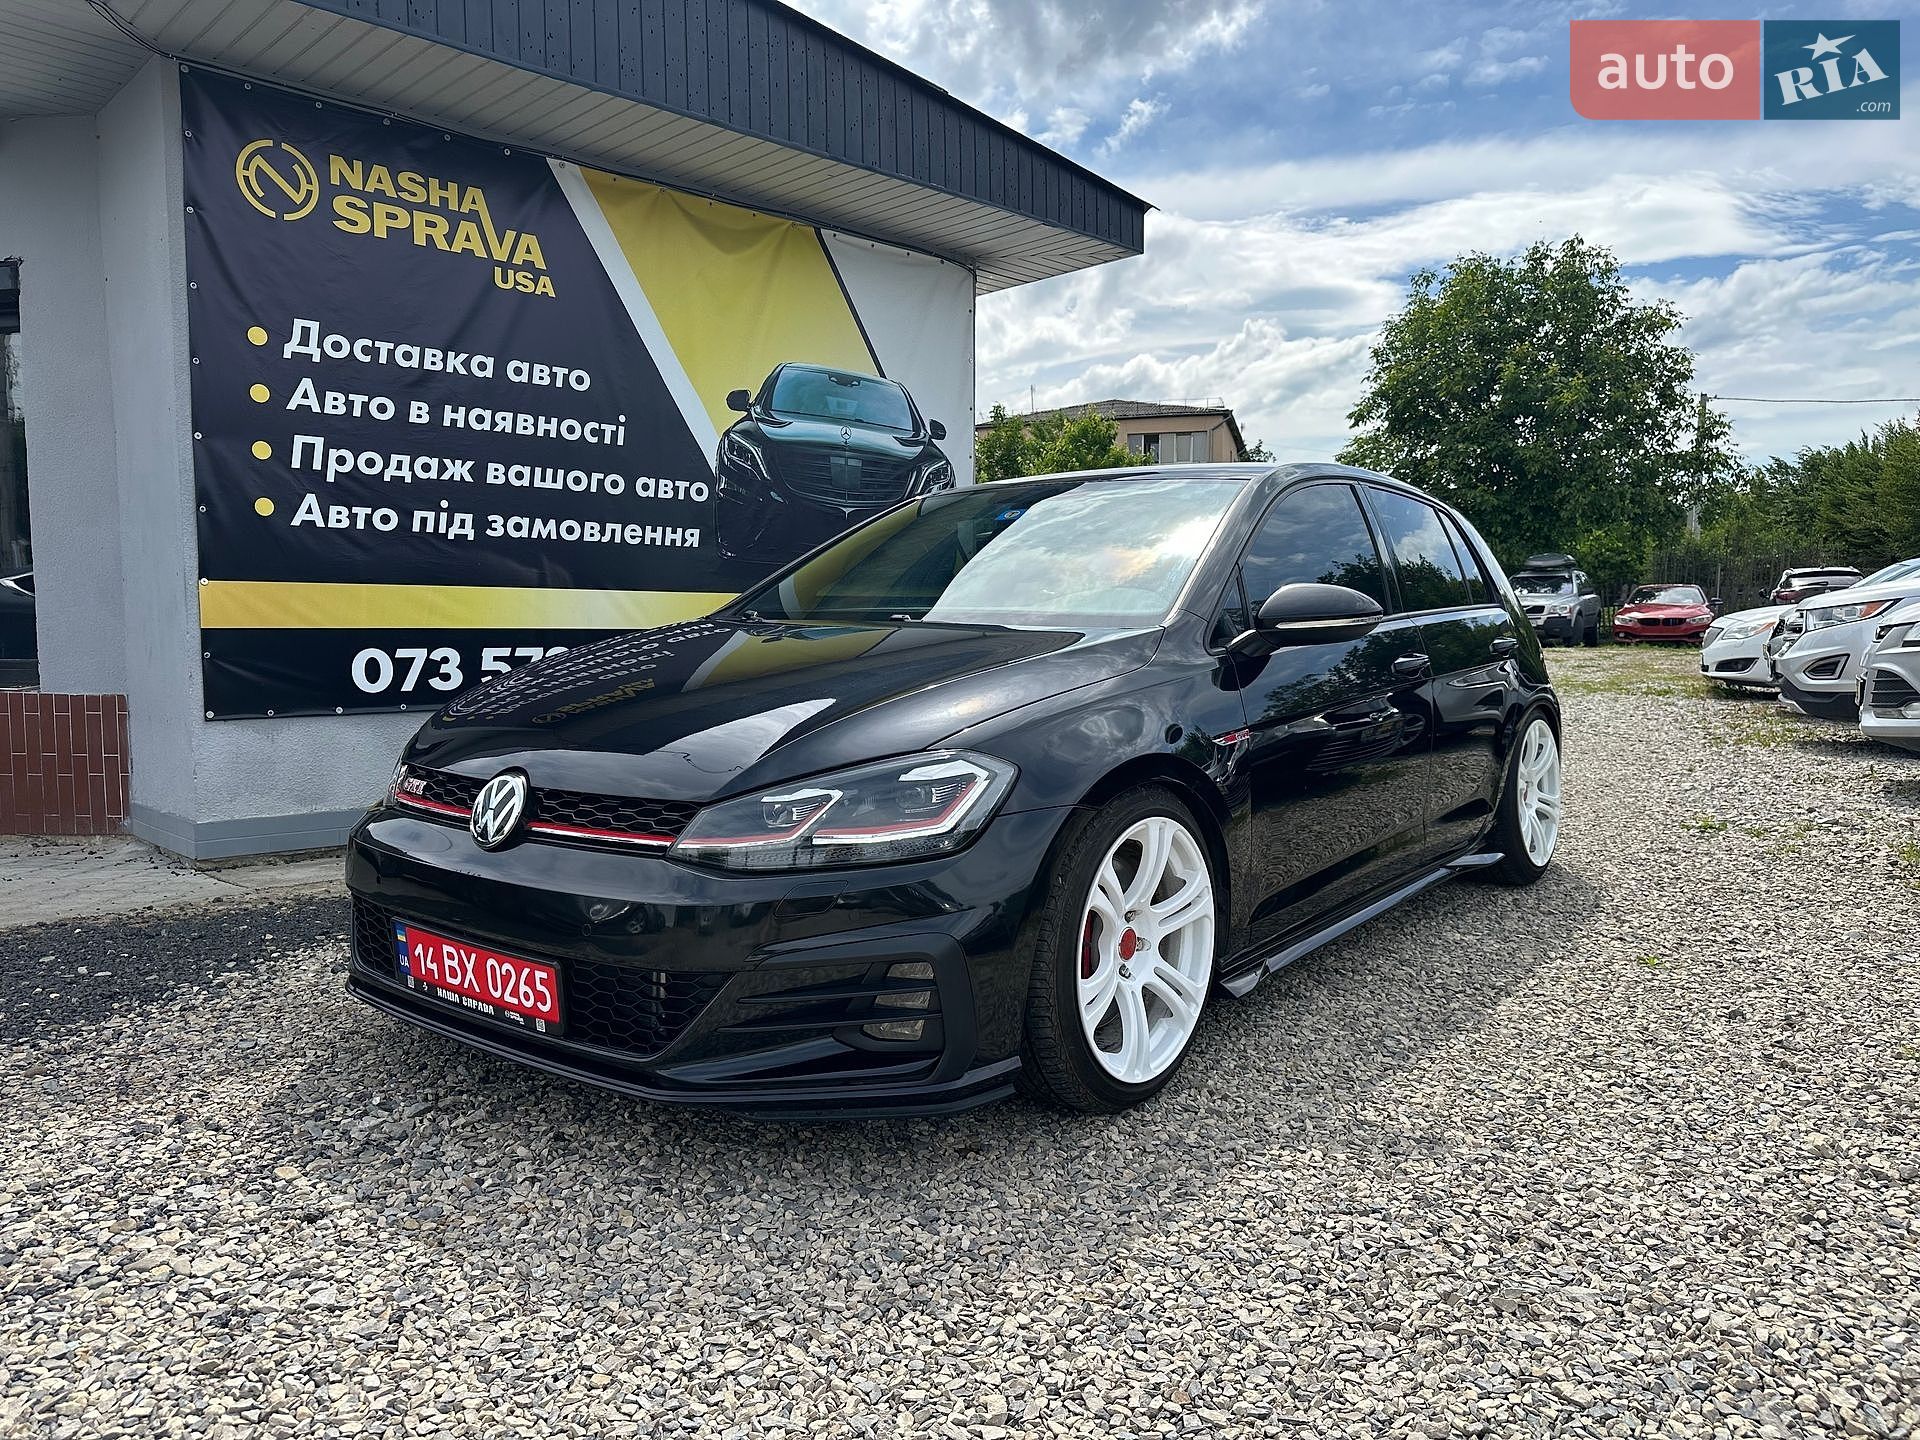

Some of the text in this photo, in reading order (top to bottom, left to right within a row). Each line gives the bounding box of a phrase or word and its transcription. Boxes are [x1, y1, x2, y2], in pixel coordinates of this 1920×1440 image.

[329, 154, 488, 214] NASHA
[332, 192, 547, 270] SPRAVA
[494, 265, 557, 298] USA
[283, 318, 592, 393] Доставка авто
[286, 376, 627, 447] Авто в наявності
[290, 434, 710, 503] Продаж вашого авто
[290, 493, 701, 549] Авто під замовлення
[350, 646, 570, 695] 073 57
[399, 954, 410, 968] UA
[414, 943, 552, 1013] 14 BX 0265
[436, 987, 460, 1004] НАША
